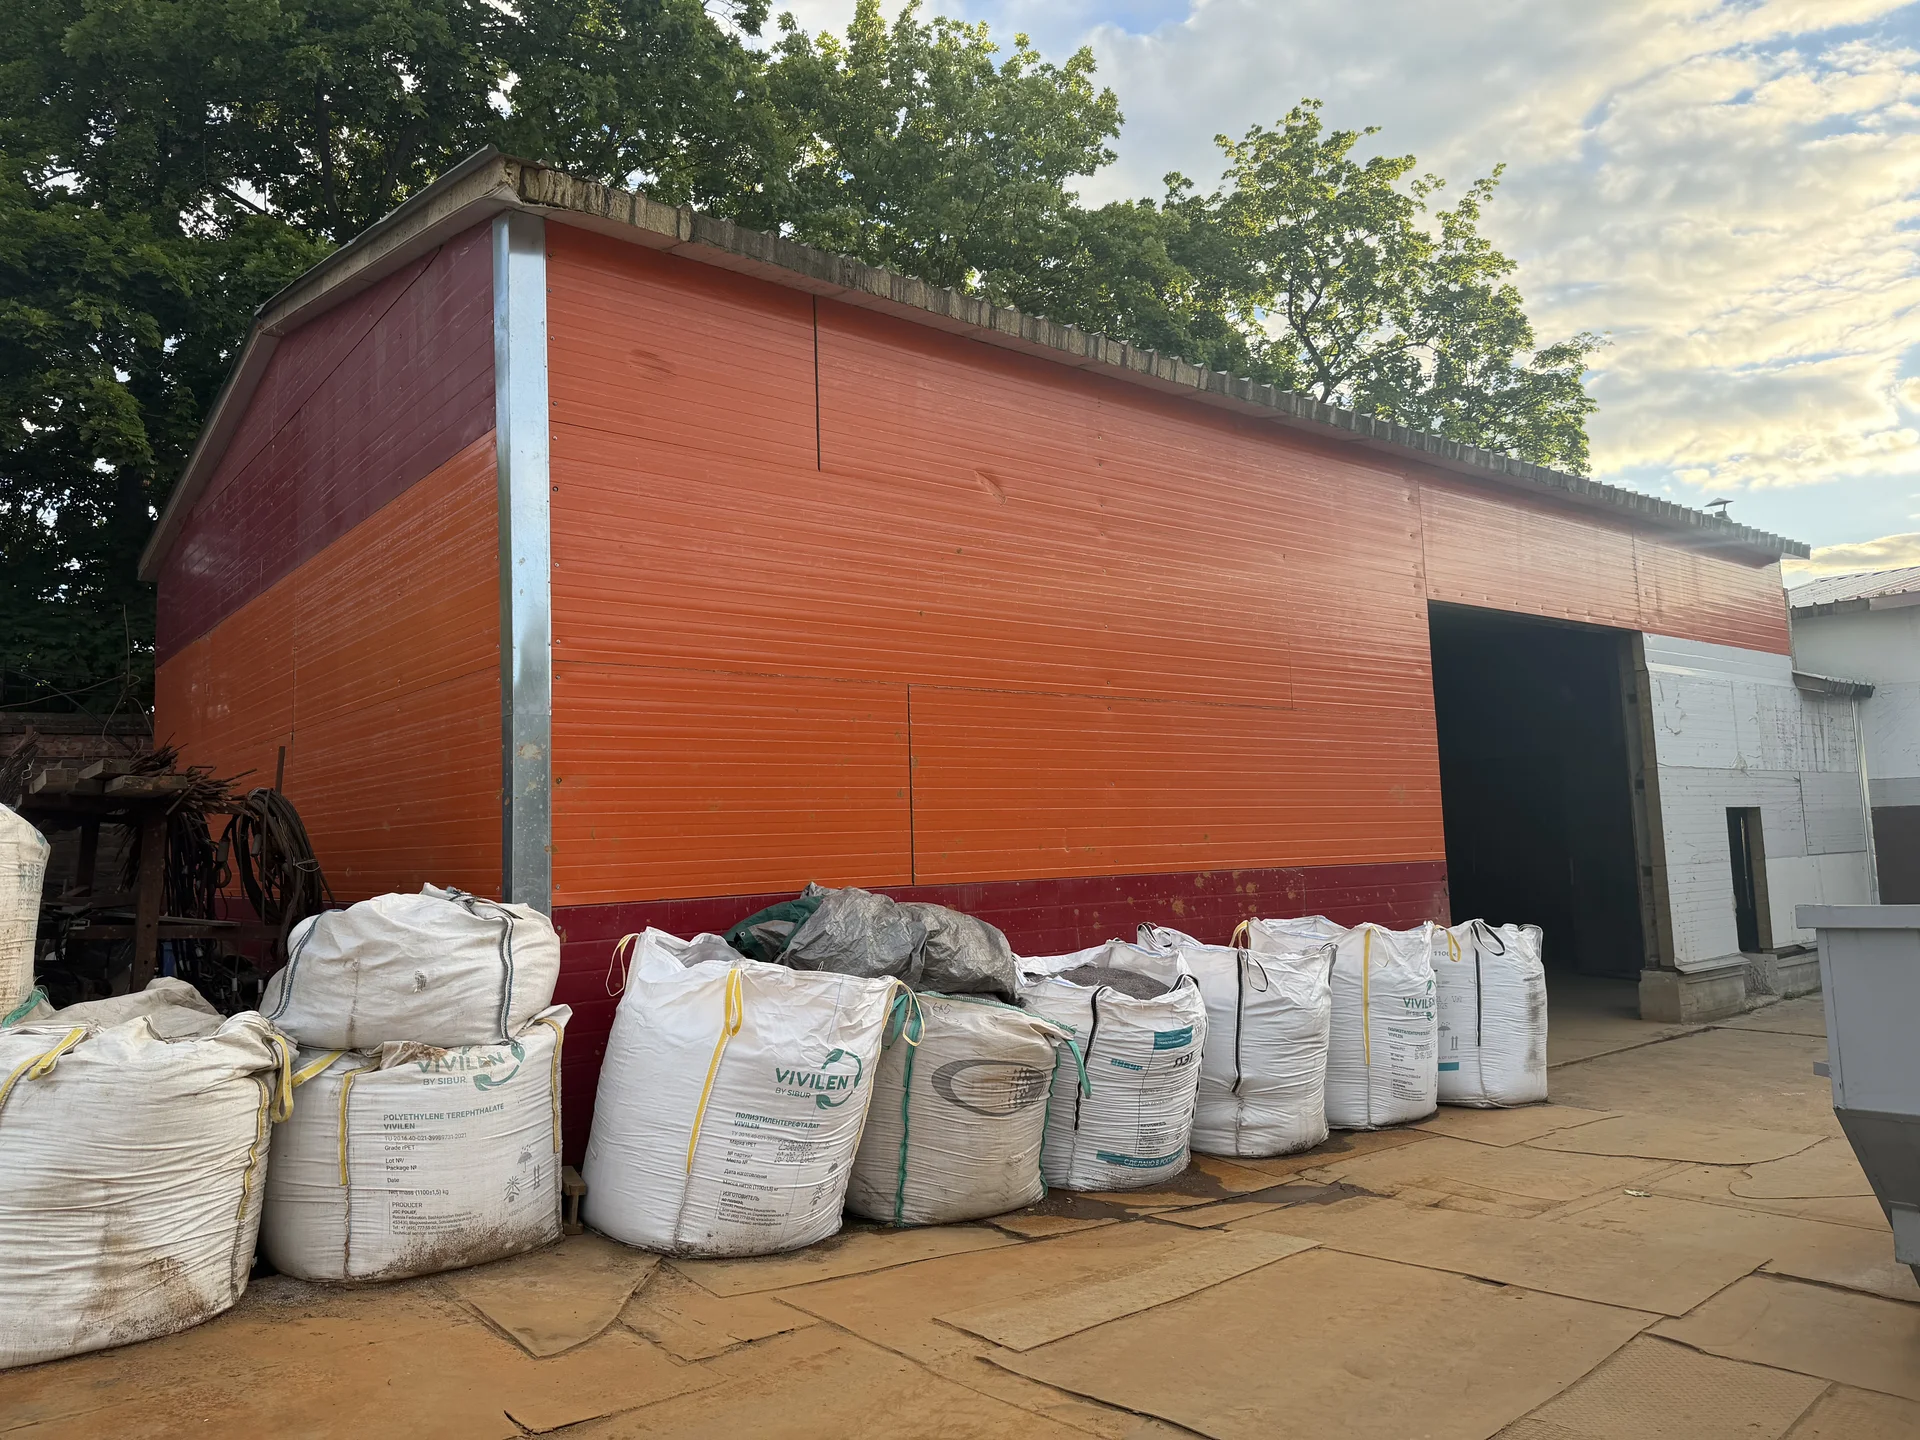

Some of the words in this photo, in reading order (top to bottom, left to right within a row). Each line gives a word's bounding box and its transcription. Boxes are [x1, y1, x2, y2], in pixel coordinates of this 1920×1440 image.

[416, 1051, 506, 1074] VIVILEN
[423, 1078, 436, 1086] BY
[437, 1076, 466, 1086] SIBUR
[775, 1067, 849, 1091] VIVILEN
[775, 1086, 787, 1095] BY
[787, 1089, 812, 1099] SIBUR
[383, 1113, 445, 1122] POLYETHYLENE
[446, 1102, 505, 1120] TEREPHTHALATE
[733, 1119, 761, 1130] VIVILEN
[735, 1111, 821, 1129] ПОЛИЭТИЛЕНТЕРЕФТАЛАТ
[383, 1122, 416, 1131] VIVILEN
[1124, 1158, 1156, 1168] СДЕЛАНО
[723, 1168, 737, 1176] Дата
[722, 1190, 760, 1202] ИЗГОТОВИТЕЛЬ
[391, 1201, 424, 1209] PRODUCER
